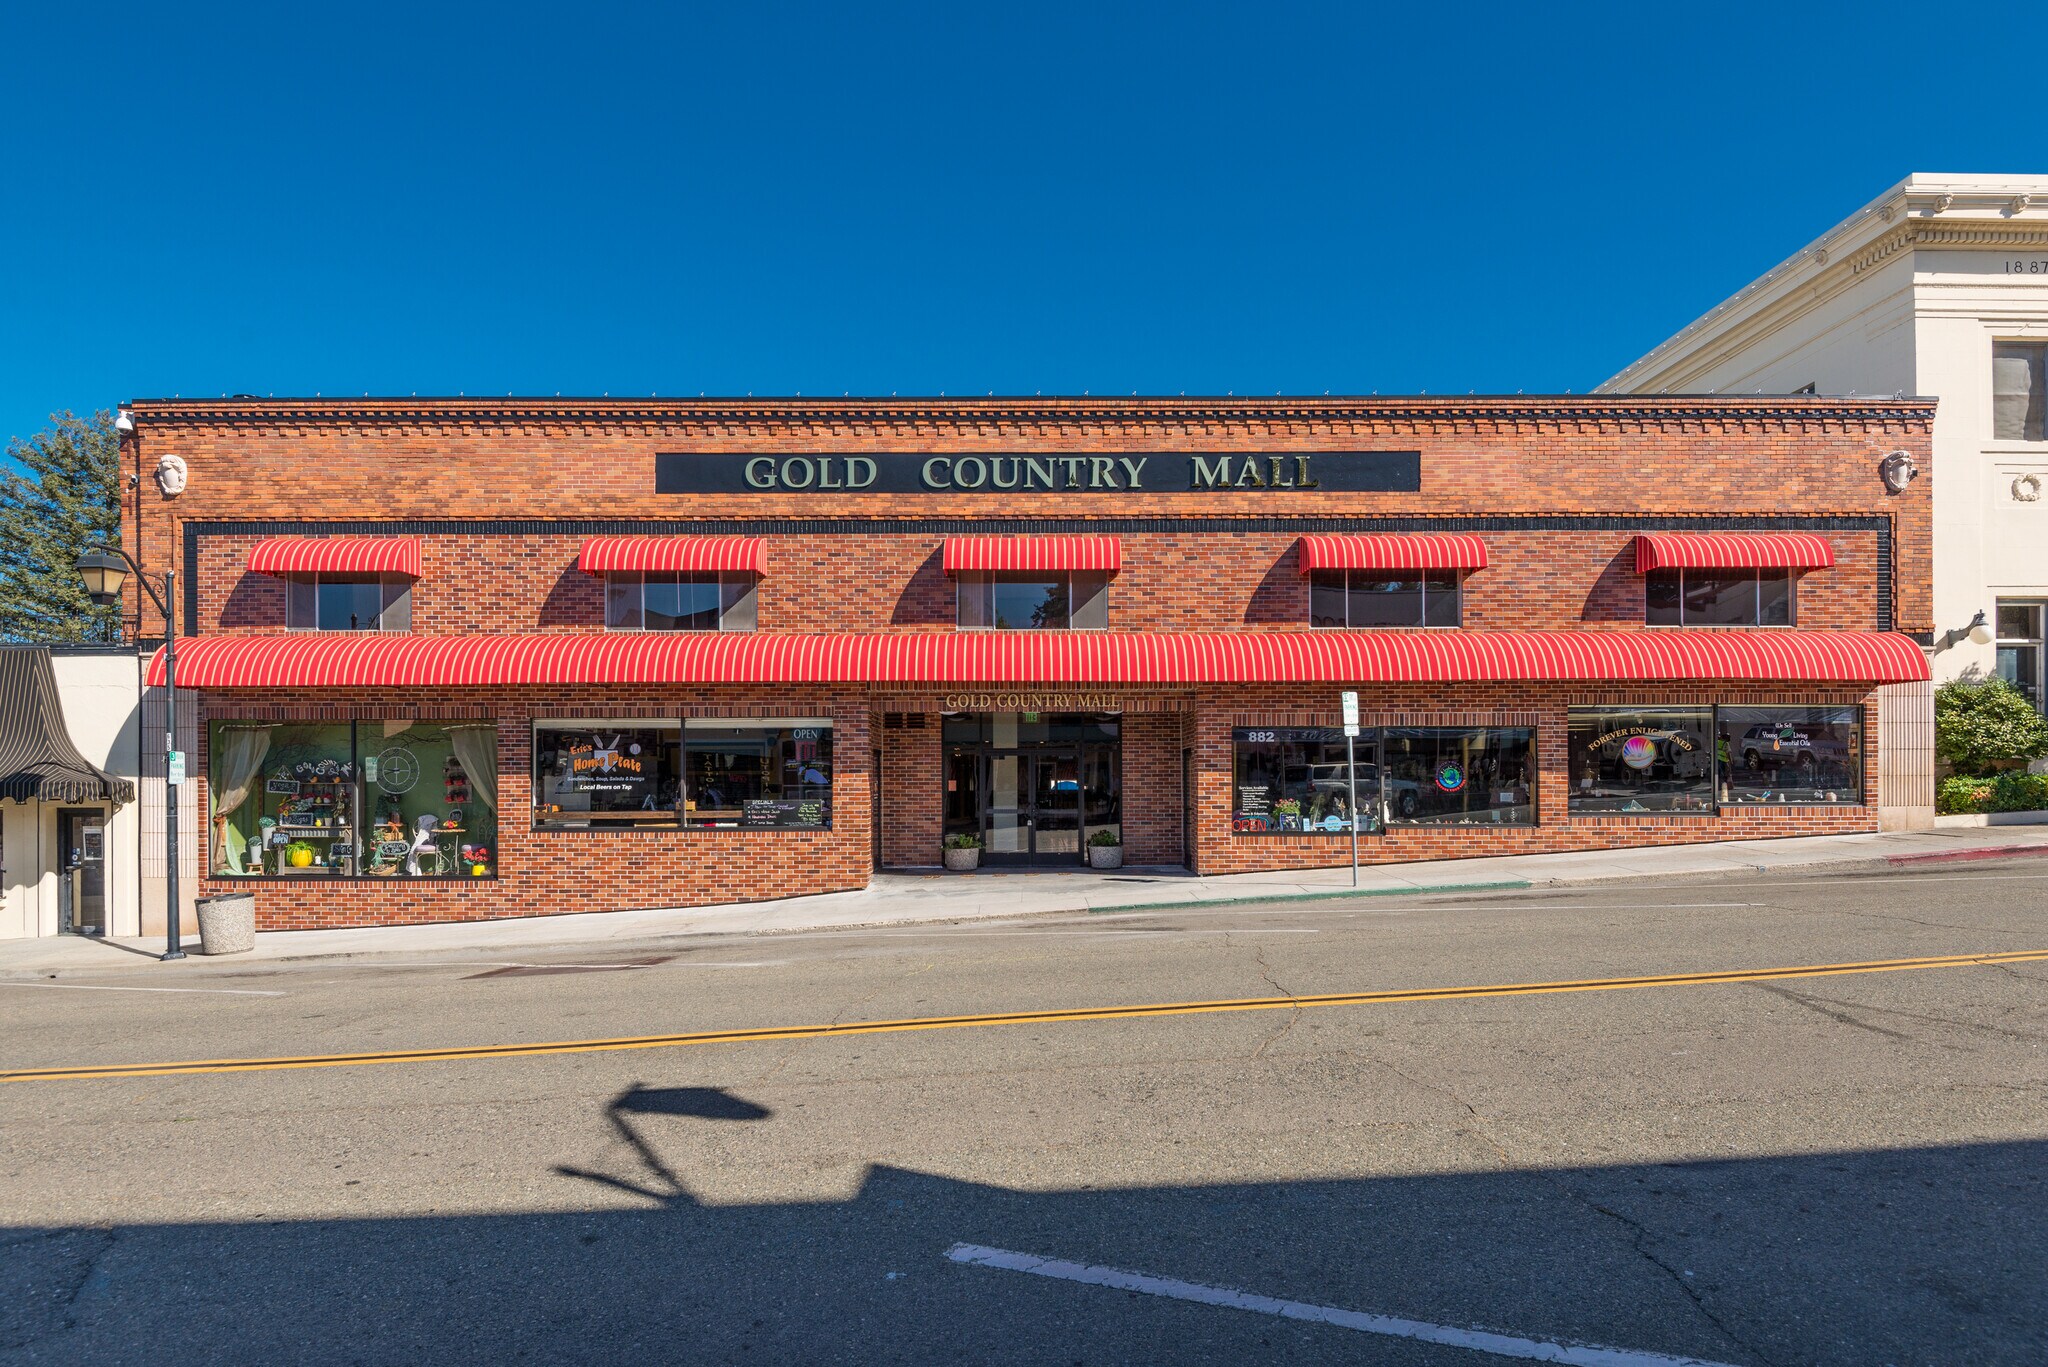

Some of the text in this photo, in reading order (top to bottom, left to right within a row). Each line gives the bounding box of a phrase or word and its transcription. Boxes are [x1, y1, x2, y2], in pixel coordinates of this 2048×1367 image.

[745, 455, 1319, 488] GOLD COUNTRY MALL
[946, 694, 1121, 708] GOLD COUNTRY MALL
[793, 729, 818, 739] OPEN
[1248, 732, 1275, 743] 882
[1588, 728, 1629, 751] FOREVER
[1762, 731, 1809, 740] Young Living
[570, 744, 593, 755] Eric's
[573, 752, 641, 773] Home Plate
[1232, 819, 1266, 832] OPEN
